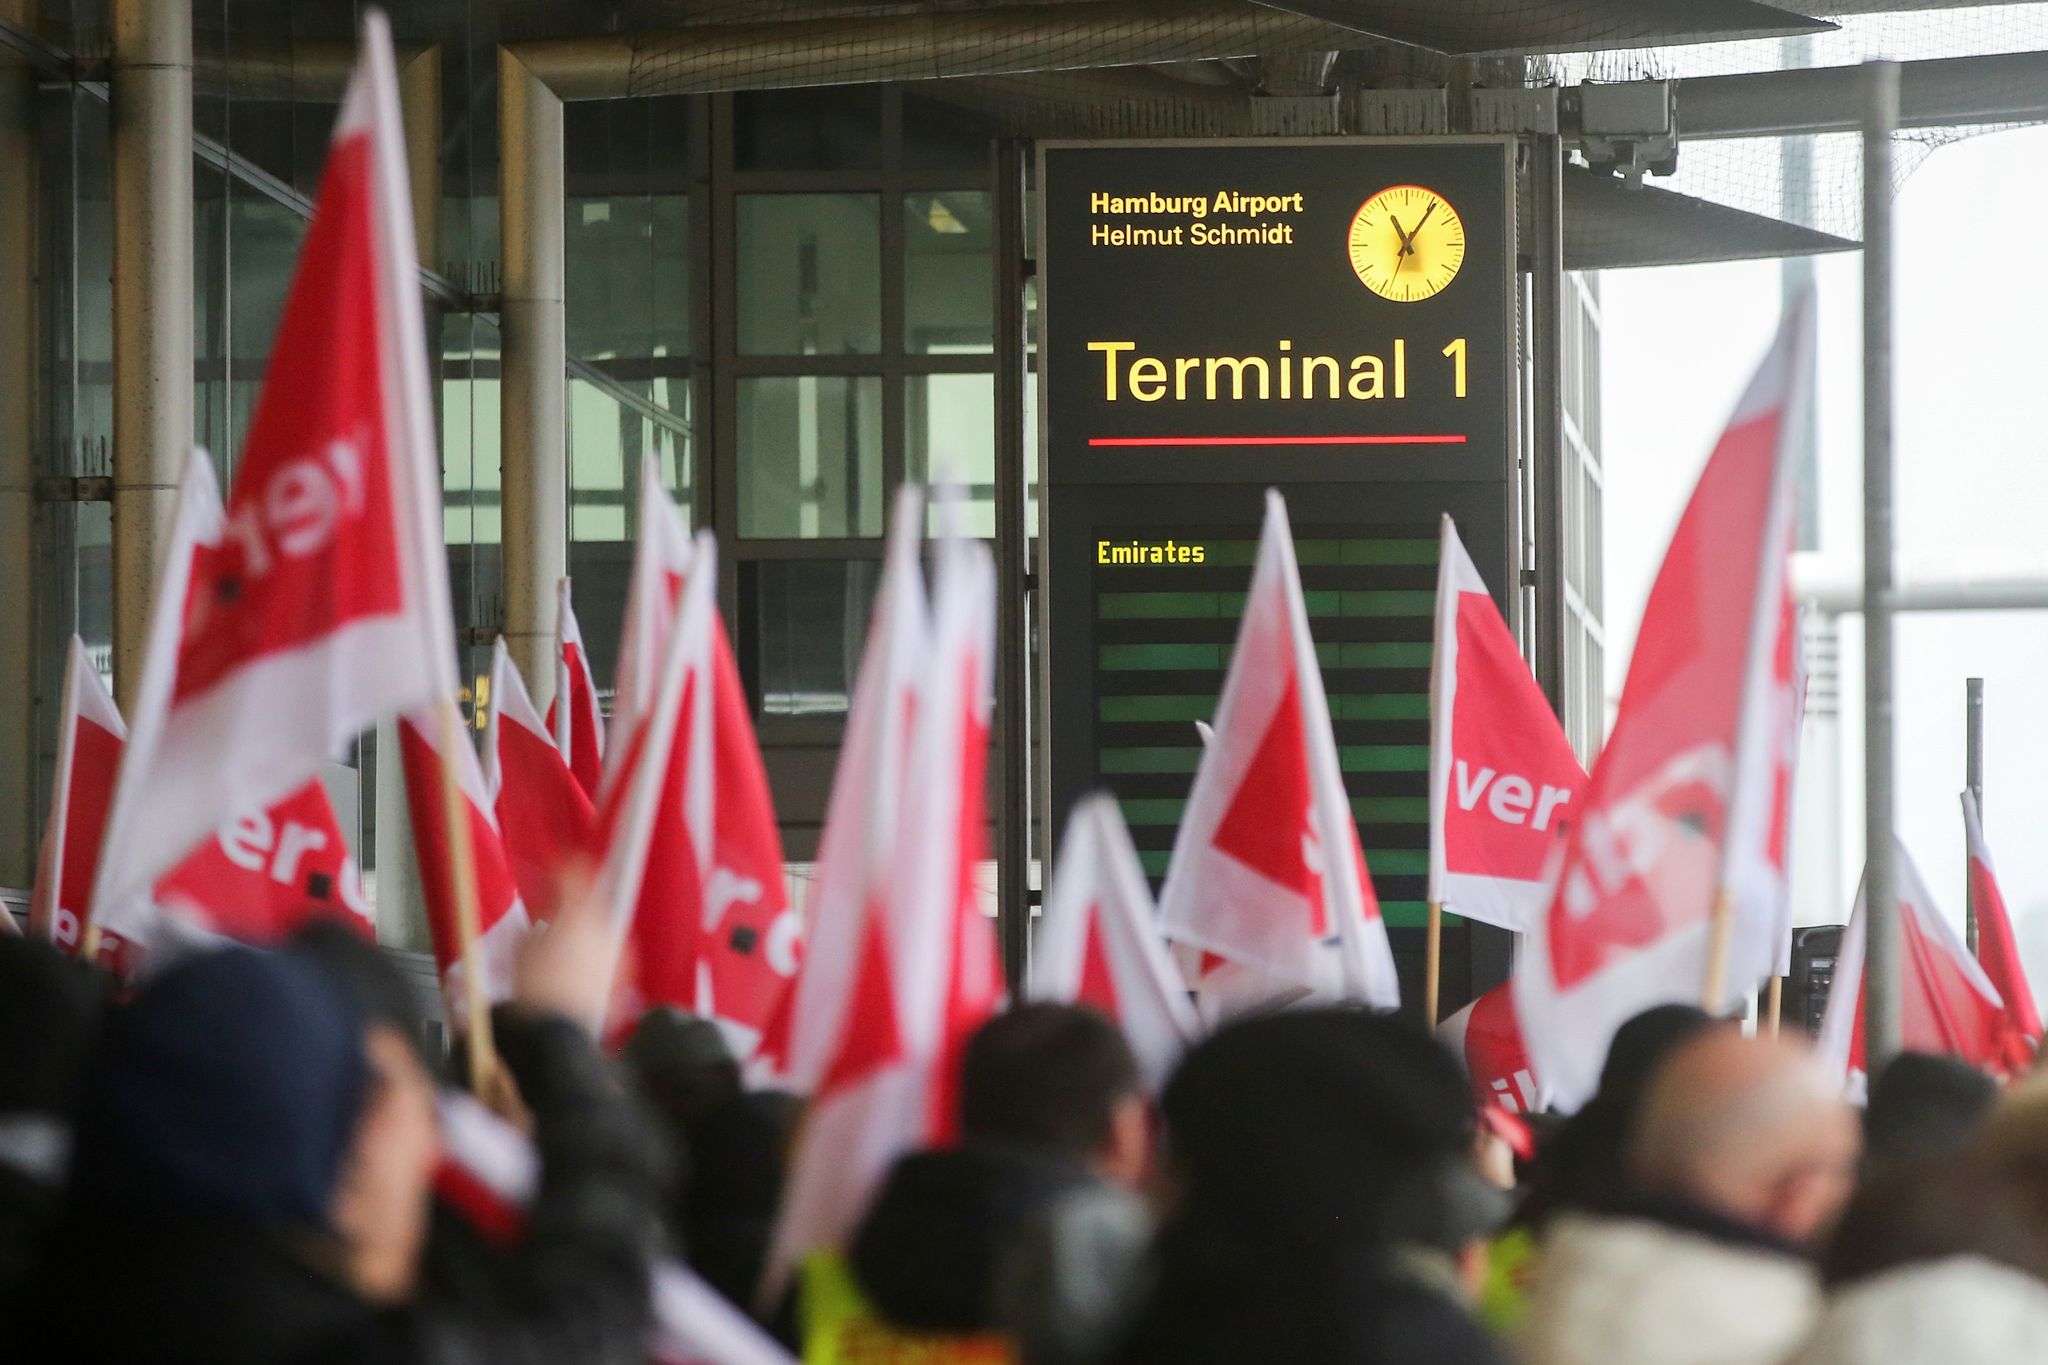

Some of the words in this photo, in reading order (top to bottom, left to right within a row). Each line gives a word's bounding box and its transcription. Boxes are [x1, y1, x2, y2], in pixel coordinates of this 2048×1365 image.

[1091, 192, 1207, 218] Hamburg
[1213, 192, 1304, 218] Airport
[1092, 223, 1183, 246] Helmut
[1191, 222, 1293, 246] Schmidt
[1087, 339, 1405, 402] Terminal
[1441, 338, 1467, 399] 1
[1098, 541, 1205, 565] Emirates
